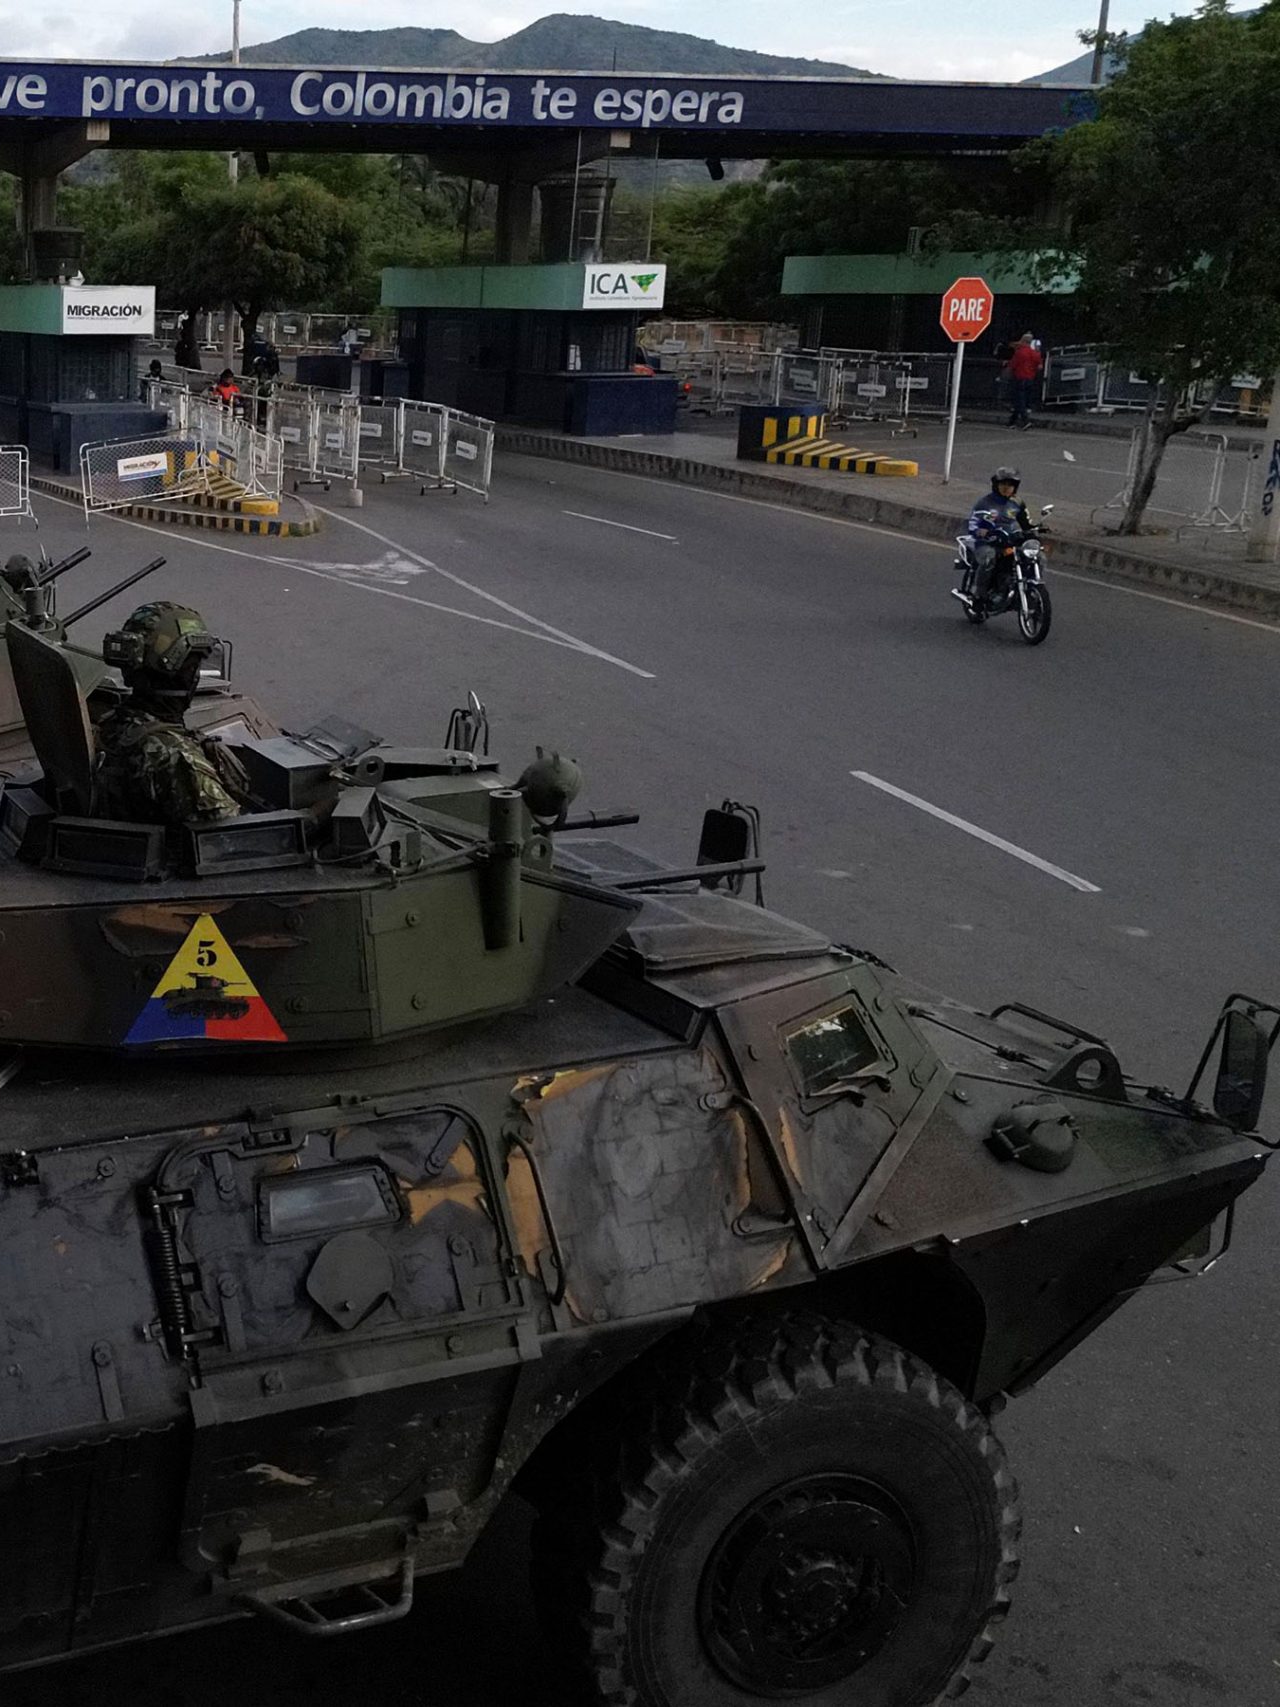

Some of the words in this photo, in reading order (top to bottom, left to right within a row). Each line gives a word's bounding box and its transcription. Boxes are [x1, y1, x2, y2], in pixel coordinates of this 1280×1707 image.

[82, 71, 265, 120] pronto,
[290, 71, 510, 120] Colombia
[531, 79, 577, 121] te
[593, 85, 745, 128] espera
[590, 273, 629, 294] ICA
[67, 302, 142, 316] MIGRACIÓN
[949, 298, 986, 321] PARE
[196, 940, 217, 966] 5
